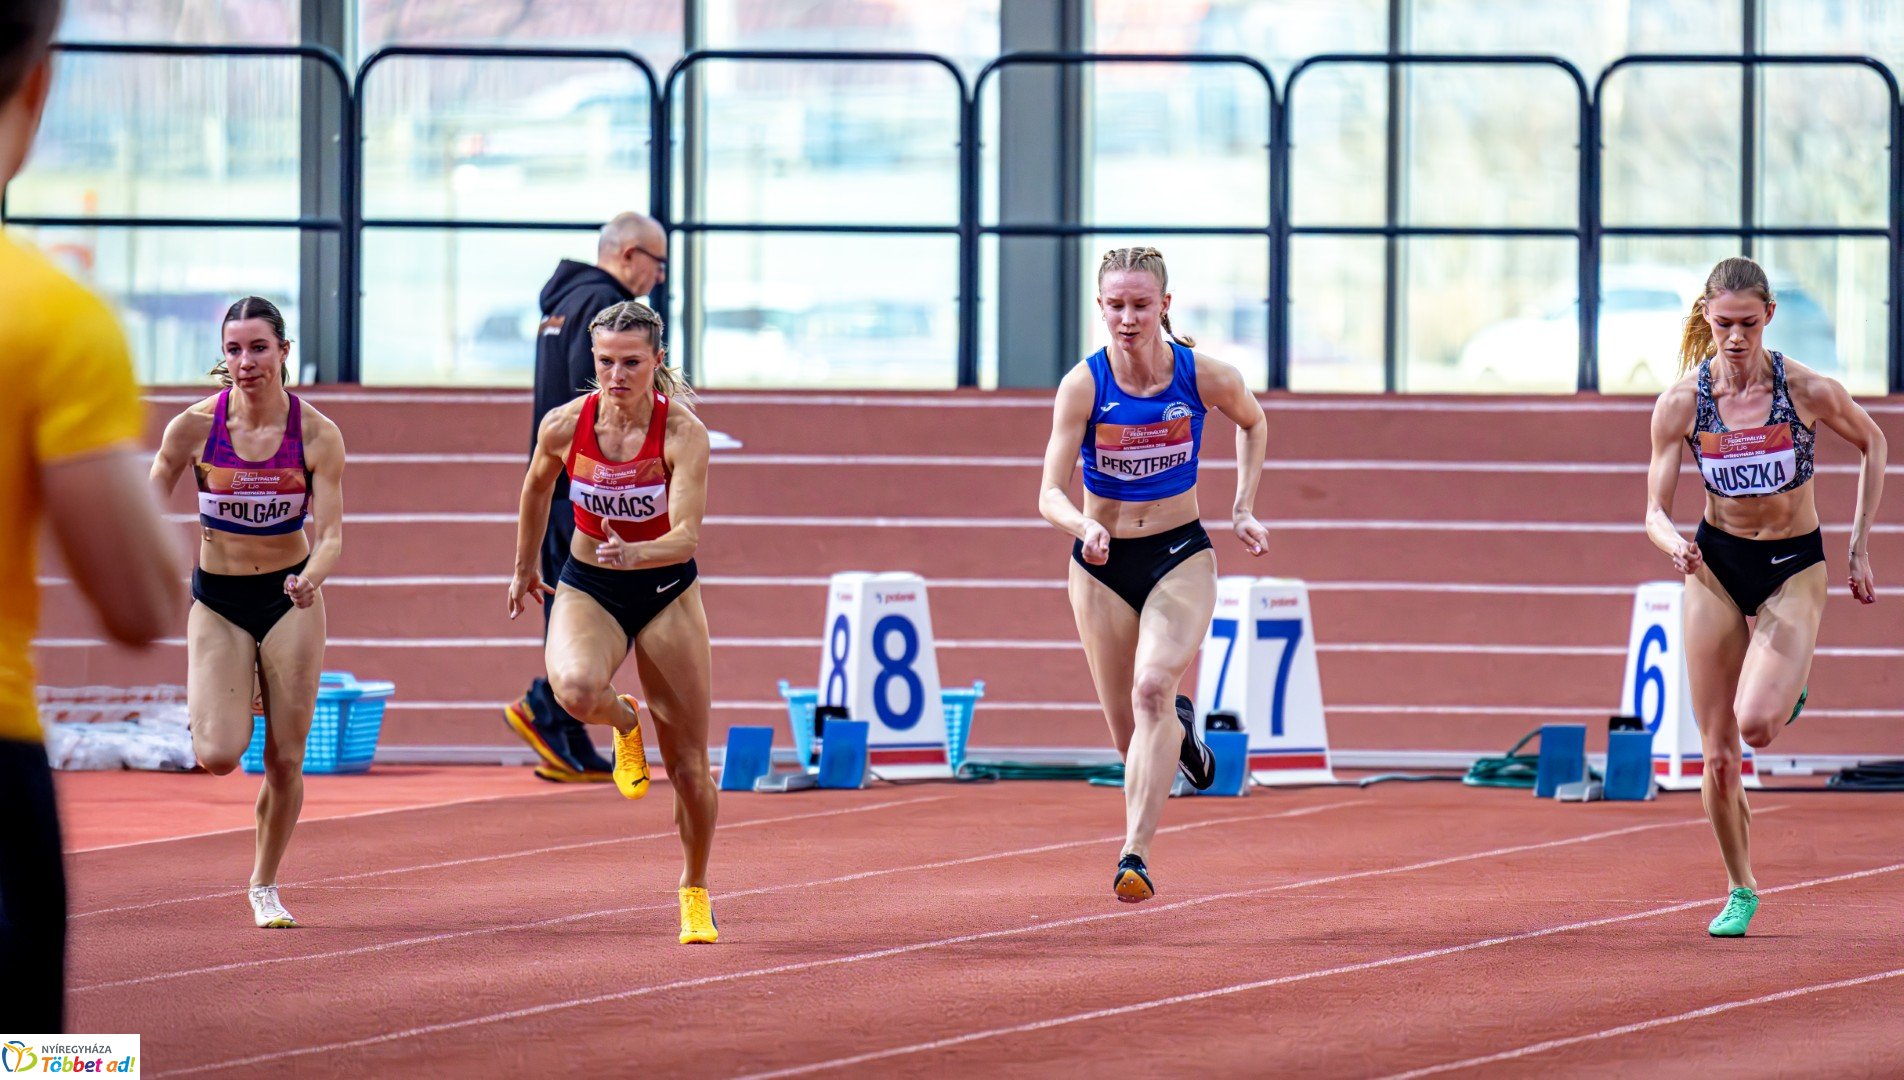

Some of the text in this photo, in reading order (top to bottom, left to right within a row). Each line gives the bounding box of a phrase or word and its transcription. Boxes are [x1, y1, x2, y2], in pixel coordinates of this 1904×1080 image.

[218, 498, 292, 523] POLGÁR
[580, 492, 656, 518] TAKÁCS
[1711, 460, 1786, 491] HUSZKA
[826, 614, 850, 706] 8
[872, 614, 925, 731] 8
[1212, 619, 1239, 710] 7
[1256, 618, 1303, 737] 7
[1634, 624, 1668, 736] 6
